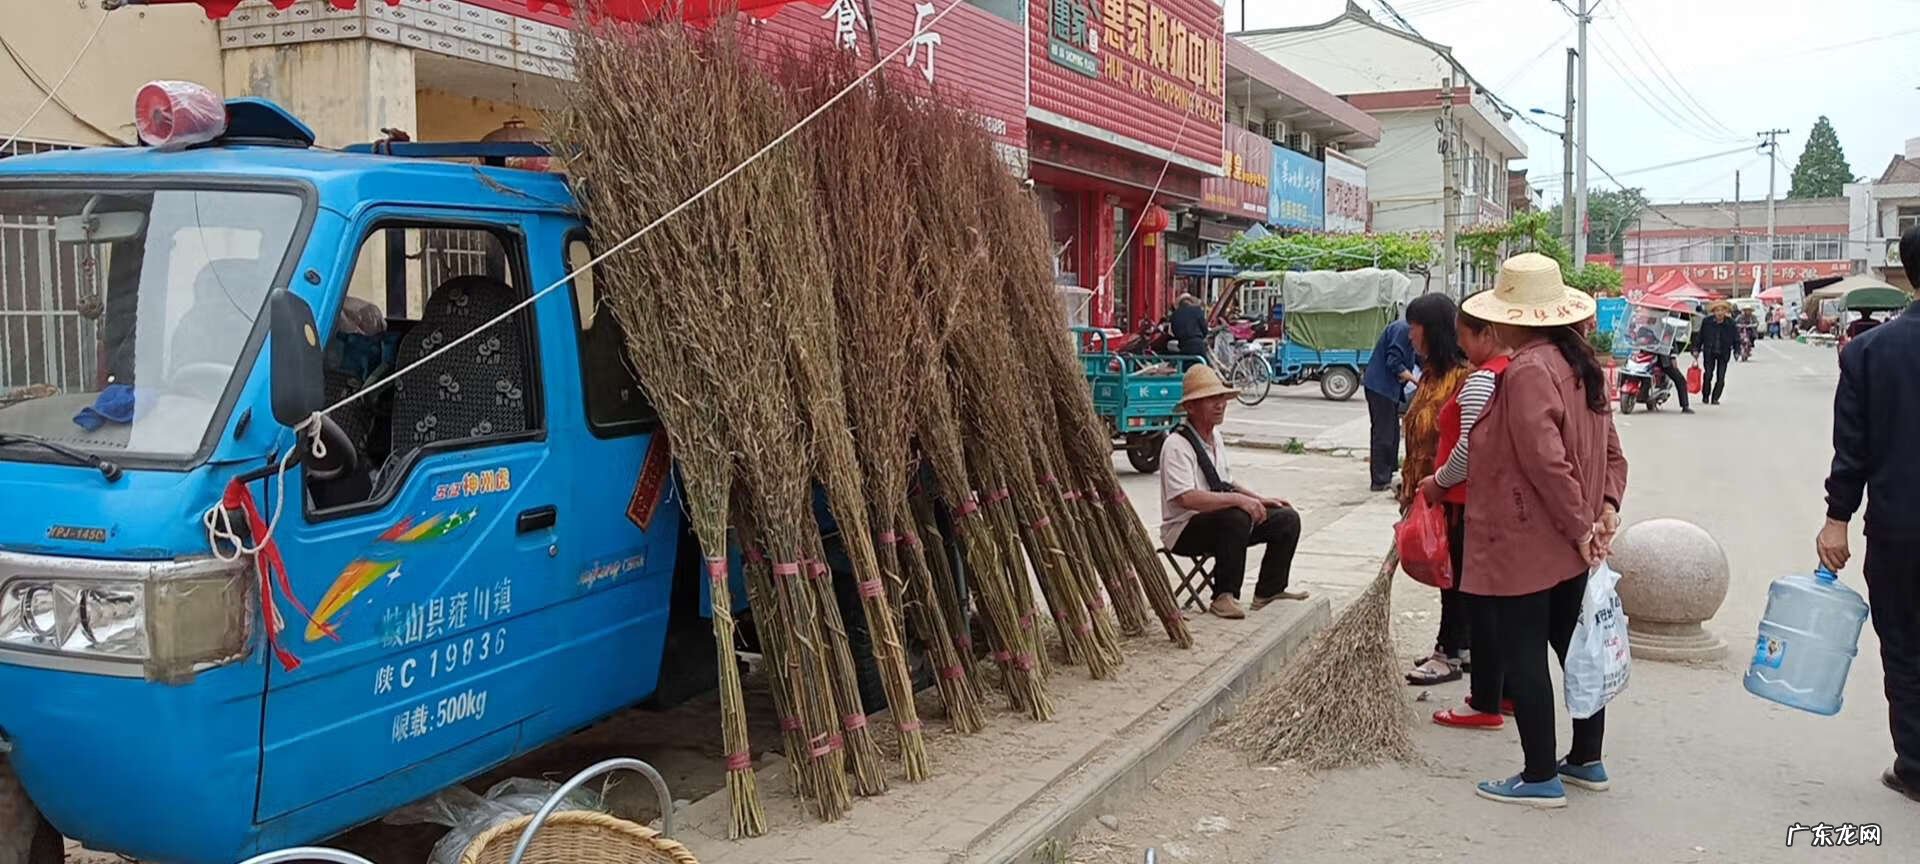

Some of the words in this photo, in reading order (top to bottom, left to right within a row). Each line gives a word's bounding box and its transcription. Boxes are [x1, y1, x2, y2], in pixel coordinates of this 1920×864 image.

[1103, 0, 1221, 97] 惠家购物中心
[430, 627, 506, 678] 19836
